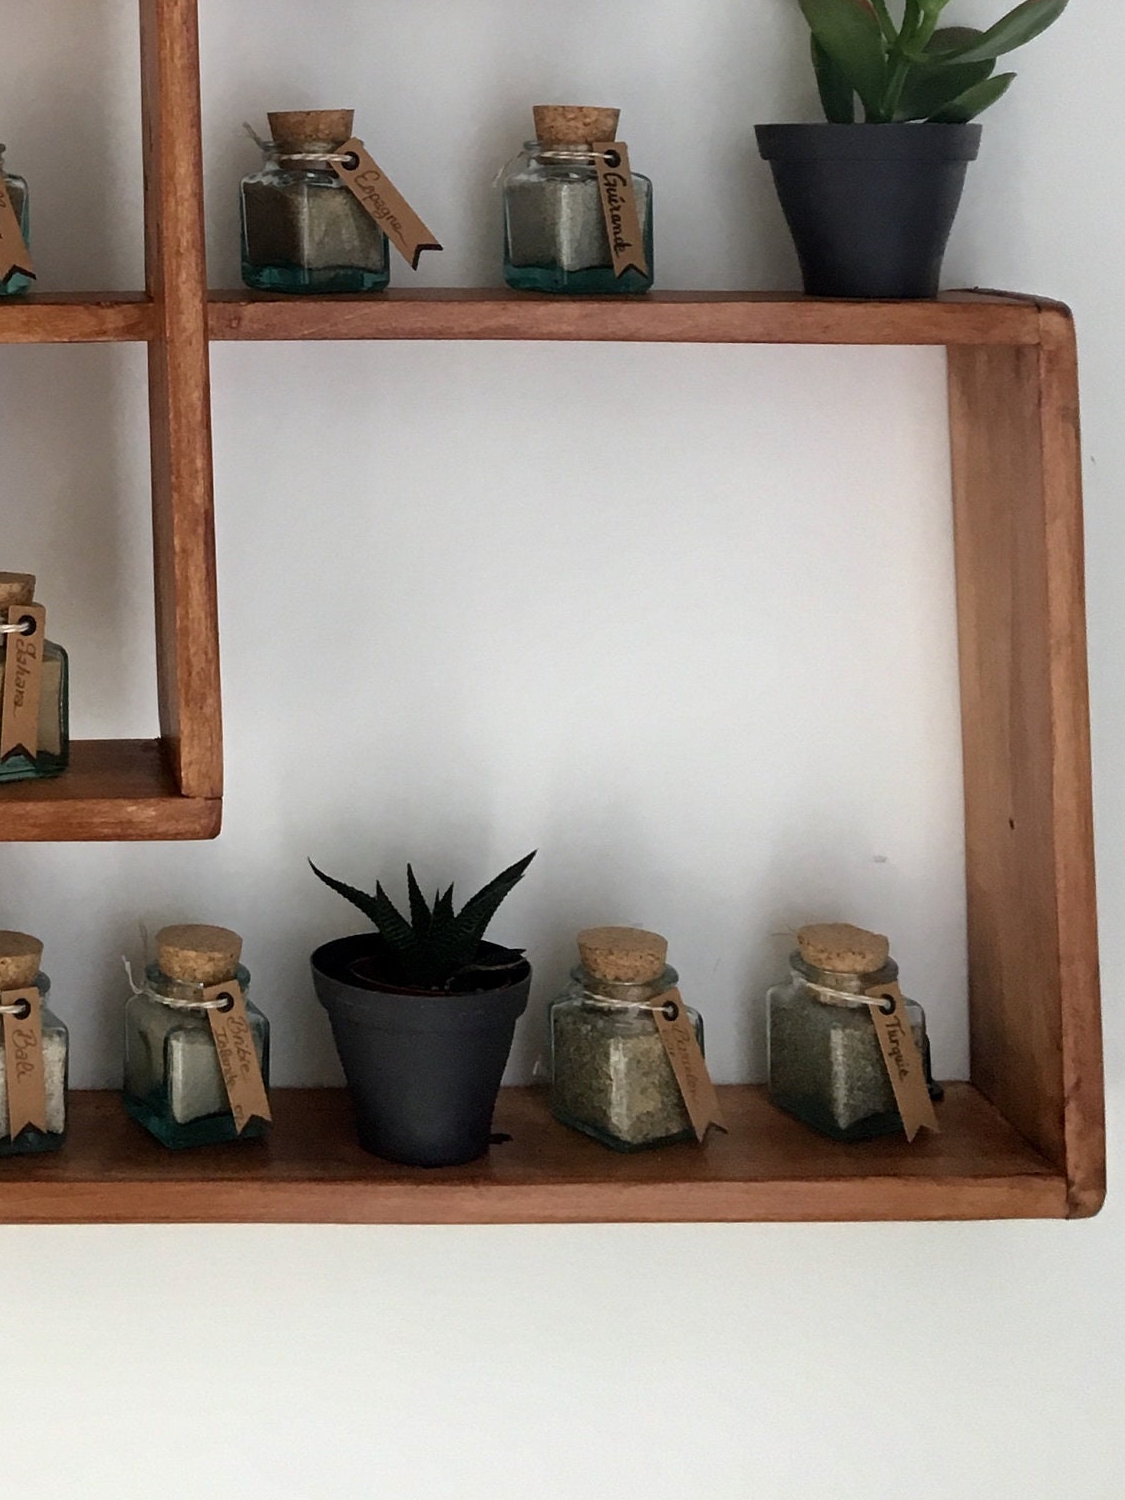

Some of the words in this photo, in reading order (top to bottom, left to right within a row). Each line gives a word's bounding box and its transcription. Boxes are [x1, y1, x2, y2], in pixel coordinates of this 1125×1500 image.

[353, 170, 409, 248] Espagne
[11, 1028, 38, 1084] Bali
[885, 1015, 911, 1084] Turquie
